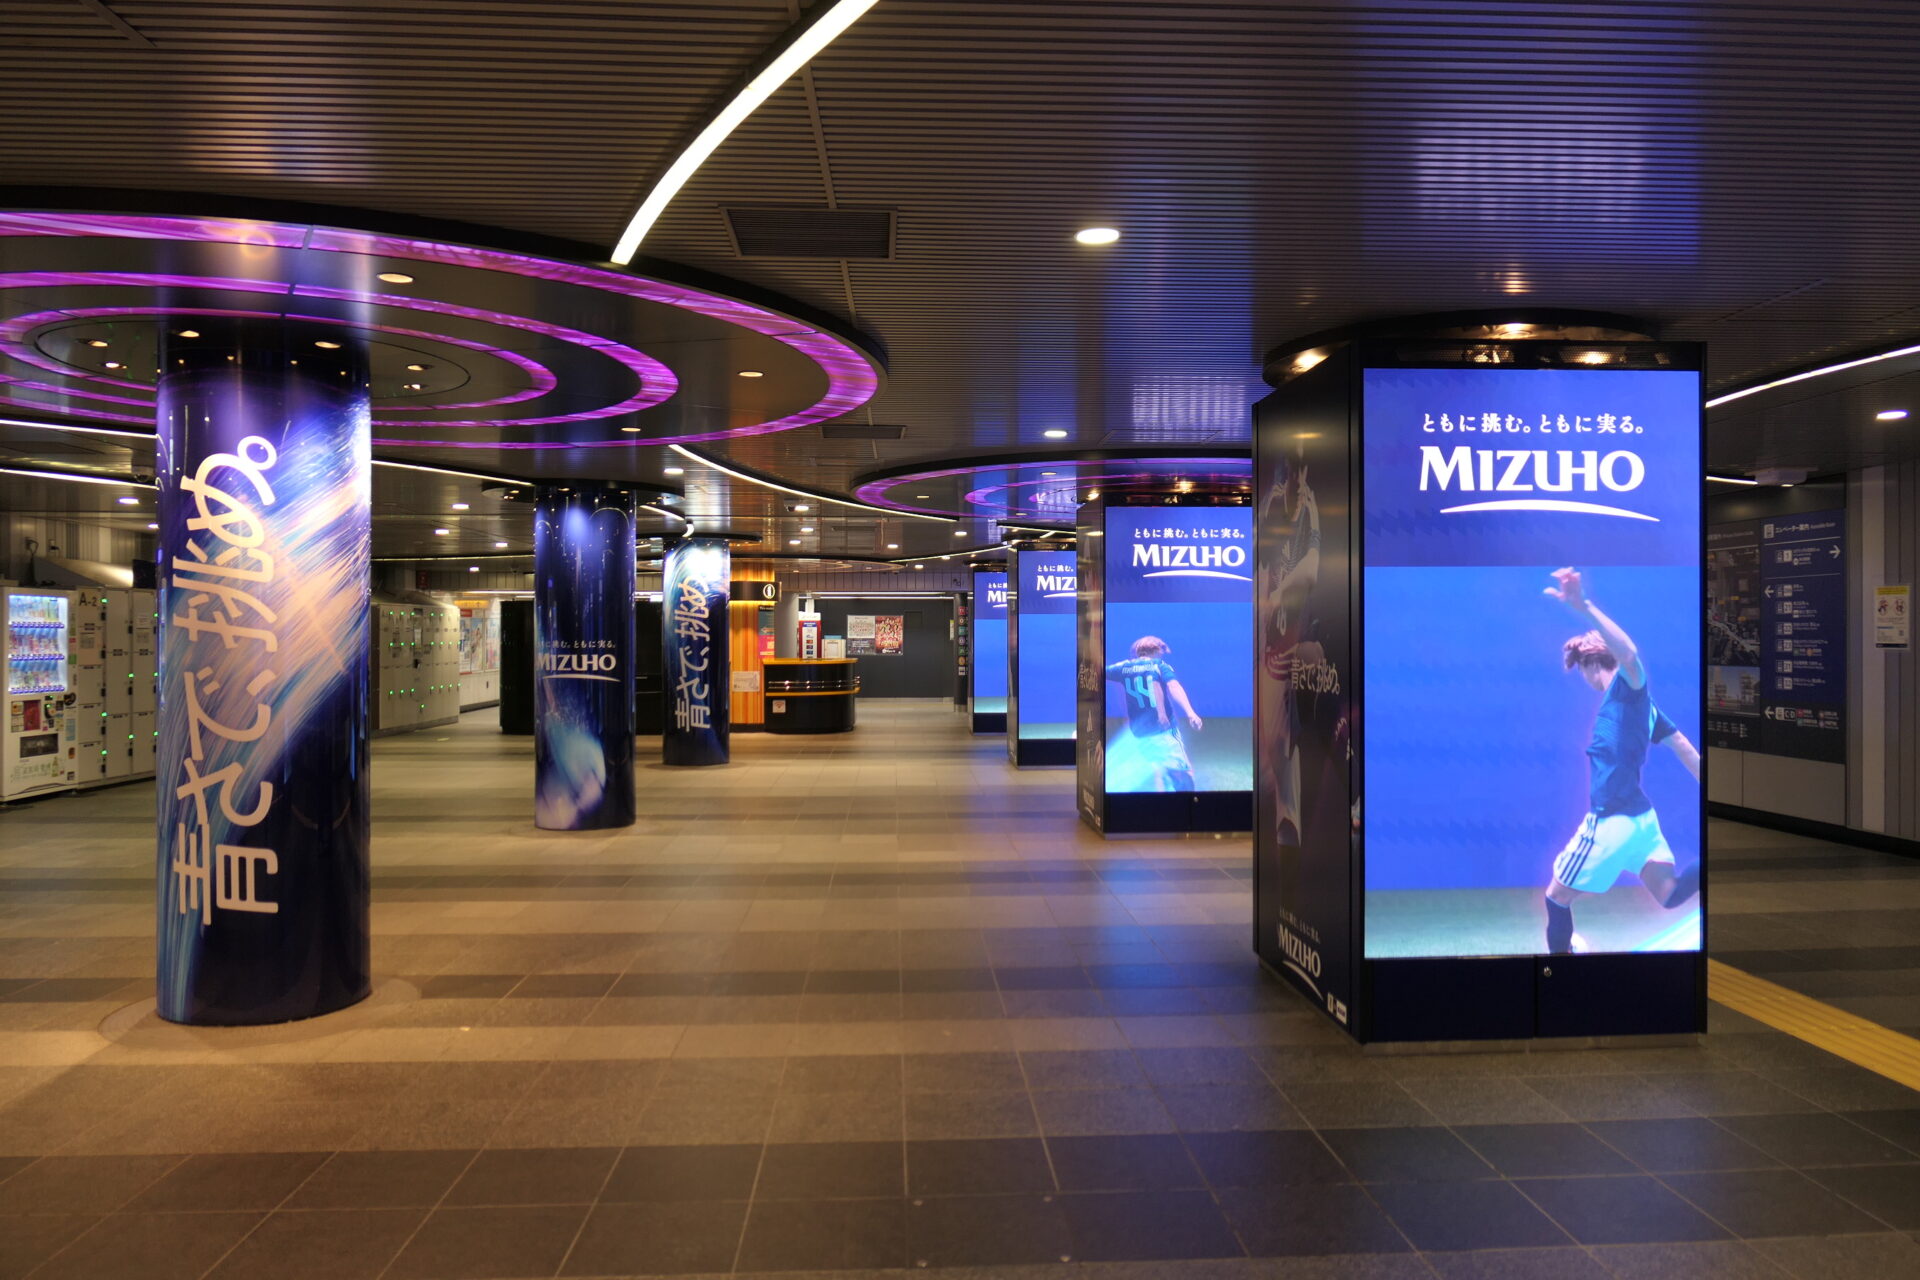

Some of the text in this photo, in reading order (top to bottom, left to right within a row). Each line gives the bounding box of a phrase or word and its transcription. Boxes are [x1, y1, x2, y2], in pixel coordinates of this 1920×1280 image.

[1423, 413, 1643, 433] ともに挑む。ともに実る。
[1420, 446, 1645, 492] MIZUHO
[1134, 528, 1245, 539] ともに挑む。ともに実る。
[1133, 543, 1245, 567] MIZUHO
[536, 653, 617, 671] MIZUHO
[173, 435, 278, 925] 青さで、挑め。
[1125, 676, 1157, 709] 44
[1278, 923, 1321, 978] MIZUHO
